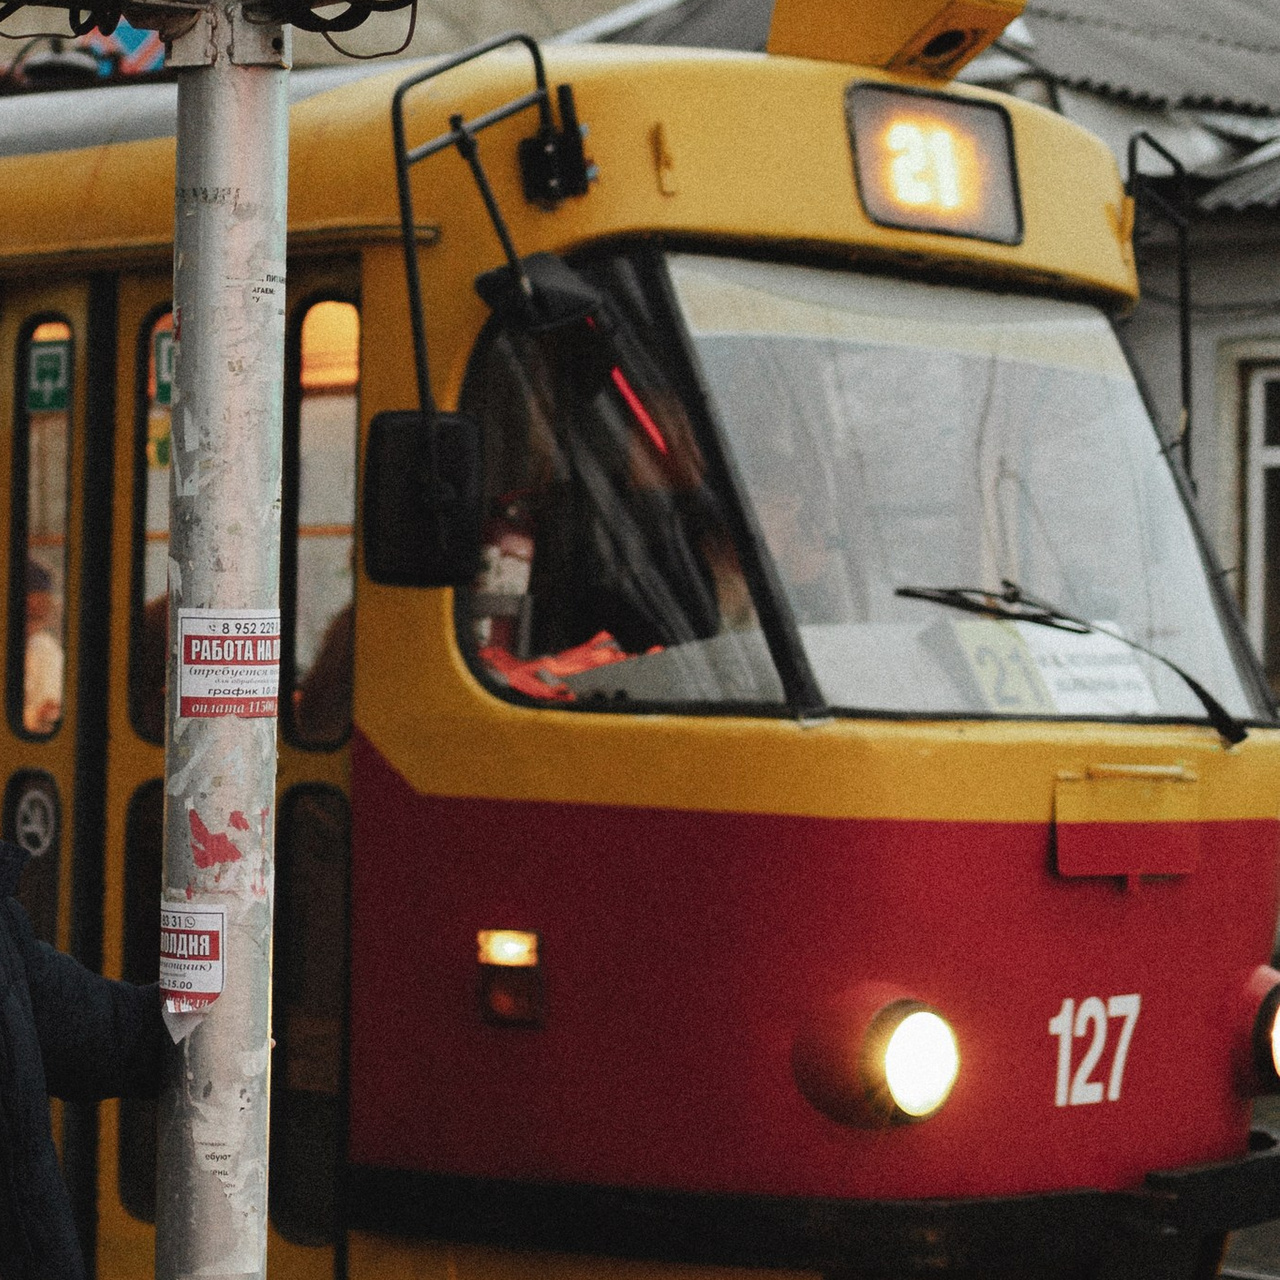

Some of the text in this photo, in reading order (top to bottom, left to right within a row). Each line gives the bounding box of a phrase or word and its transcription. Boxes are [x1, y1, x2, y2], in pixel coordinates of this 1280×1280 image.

[885, 122, 961, 208] 21
[221, 622, 231, 635] 8
[234, 622, 257, 635] 952
[191, 639, 255, 661] РАБОТА
[207, 687, 259, 697] график
[191, 702, 246, 714] оплата
[171, 915, 182, 928] 31
[1048, 992, 1141, 1107] 127
